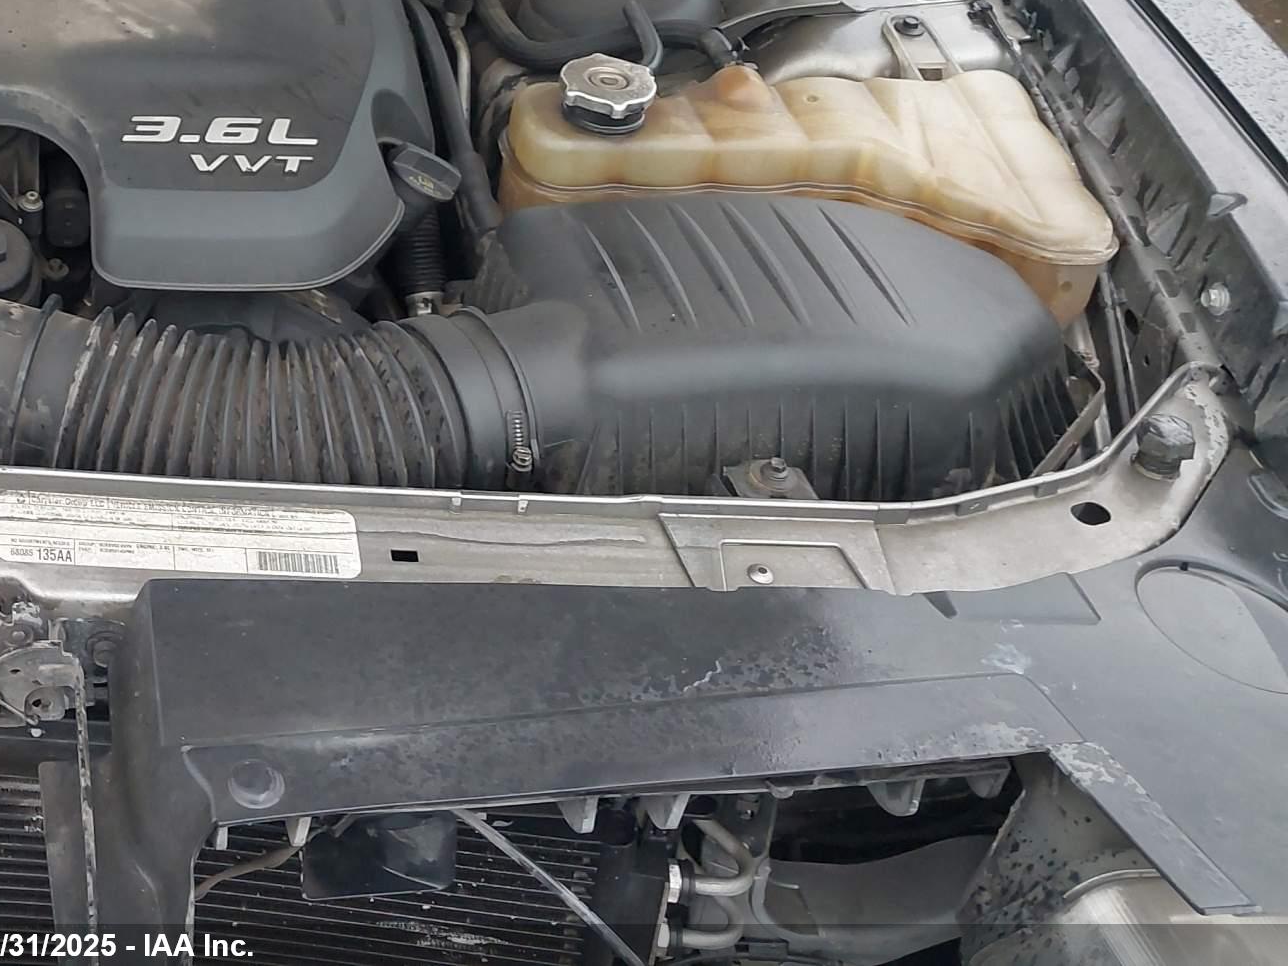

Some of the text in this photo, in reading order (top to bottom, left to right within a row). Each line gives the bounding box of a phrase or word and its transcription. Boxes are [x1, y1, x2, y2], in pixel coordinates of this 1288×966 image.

[122, 116, 318, 145] 3.6L
[190, 154, 314, 173] VVT
[37, 548, 73, 563] 135AA
